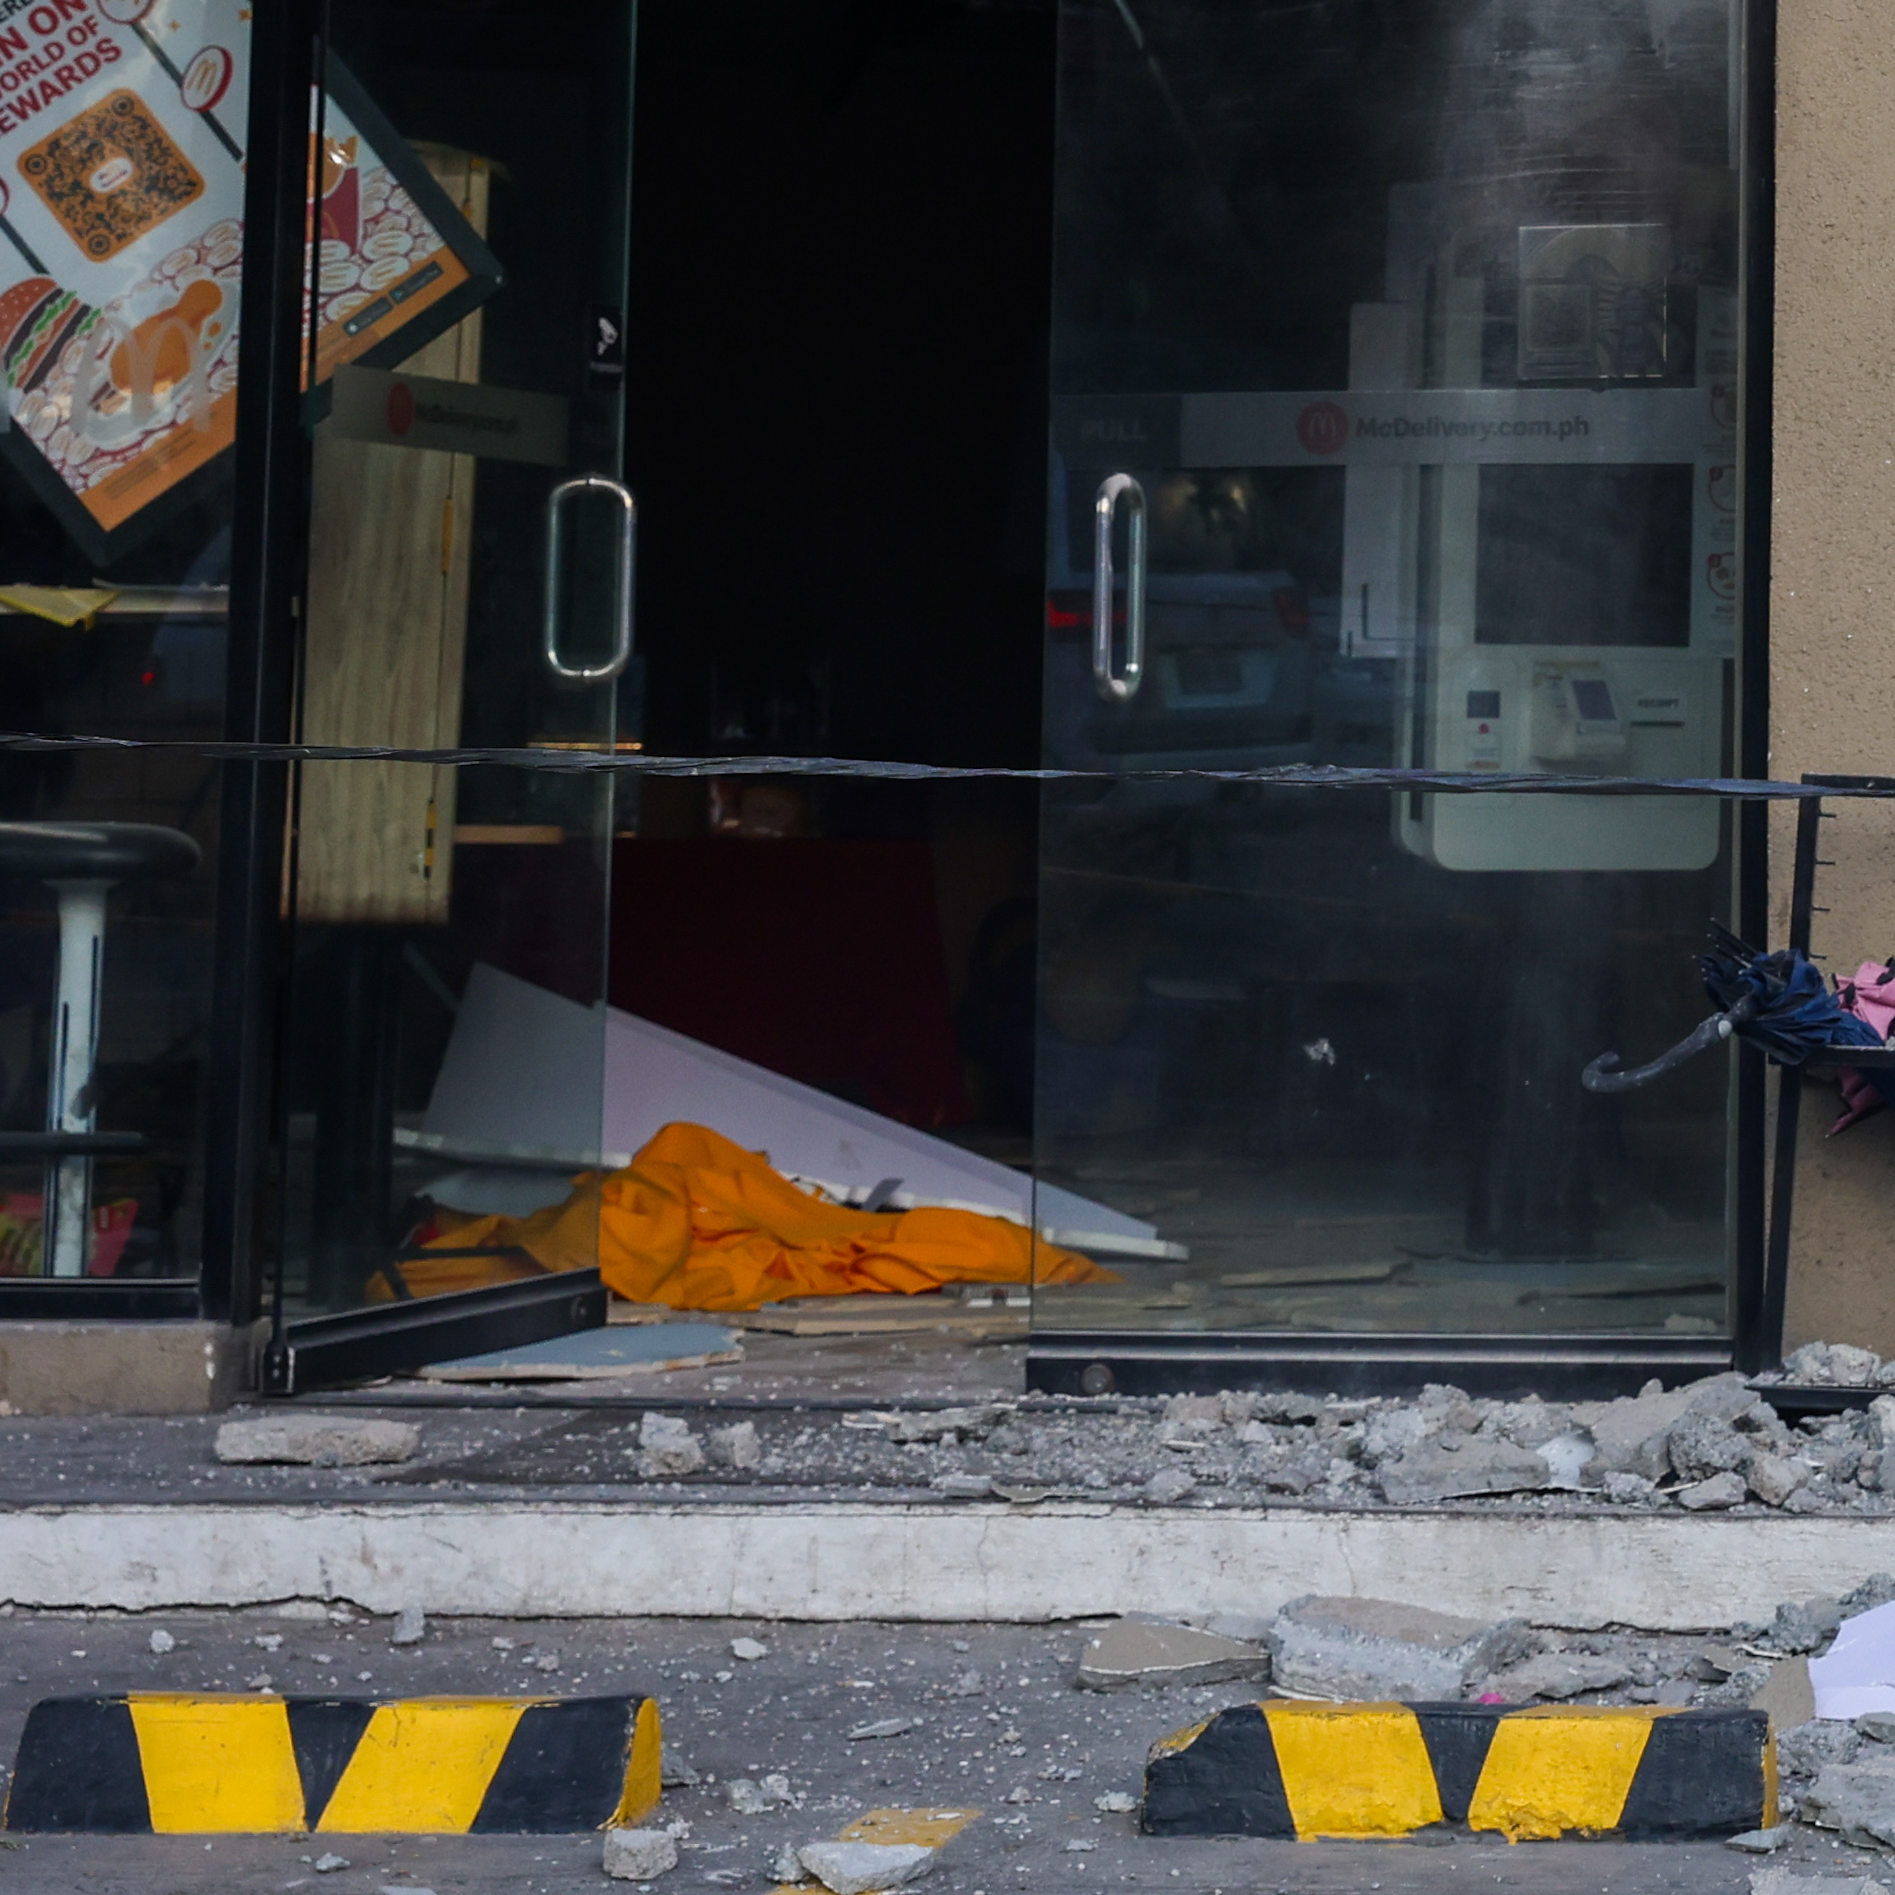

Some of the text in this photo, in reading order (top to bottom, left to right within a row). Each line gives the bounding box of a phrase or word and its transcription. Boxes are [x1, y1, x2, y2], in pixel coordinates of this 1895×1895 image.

[0, 25, 29, 67] N
[0, 14, 99, 99] ORLD OF
[0, 37, 122, 136] EWARDS
[1080, 418, 1147, 442] PULL
[1355, 415, 1590, 442] McDelivery.com.ph
